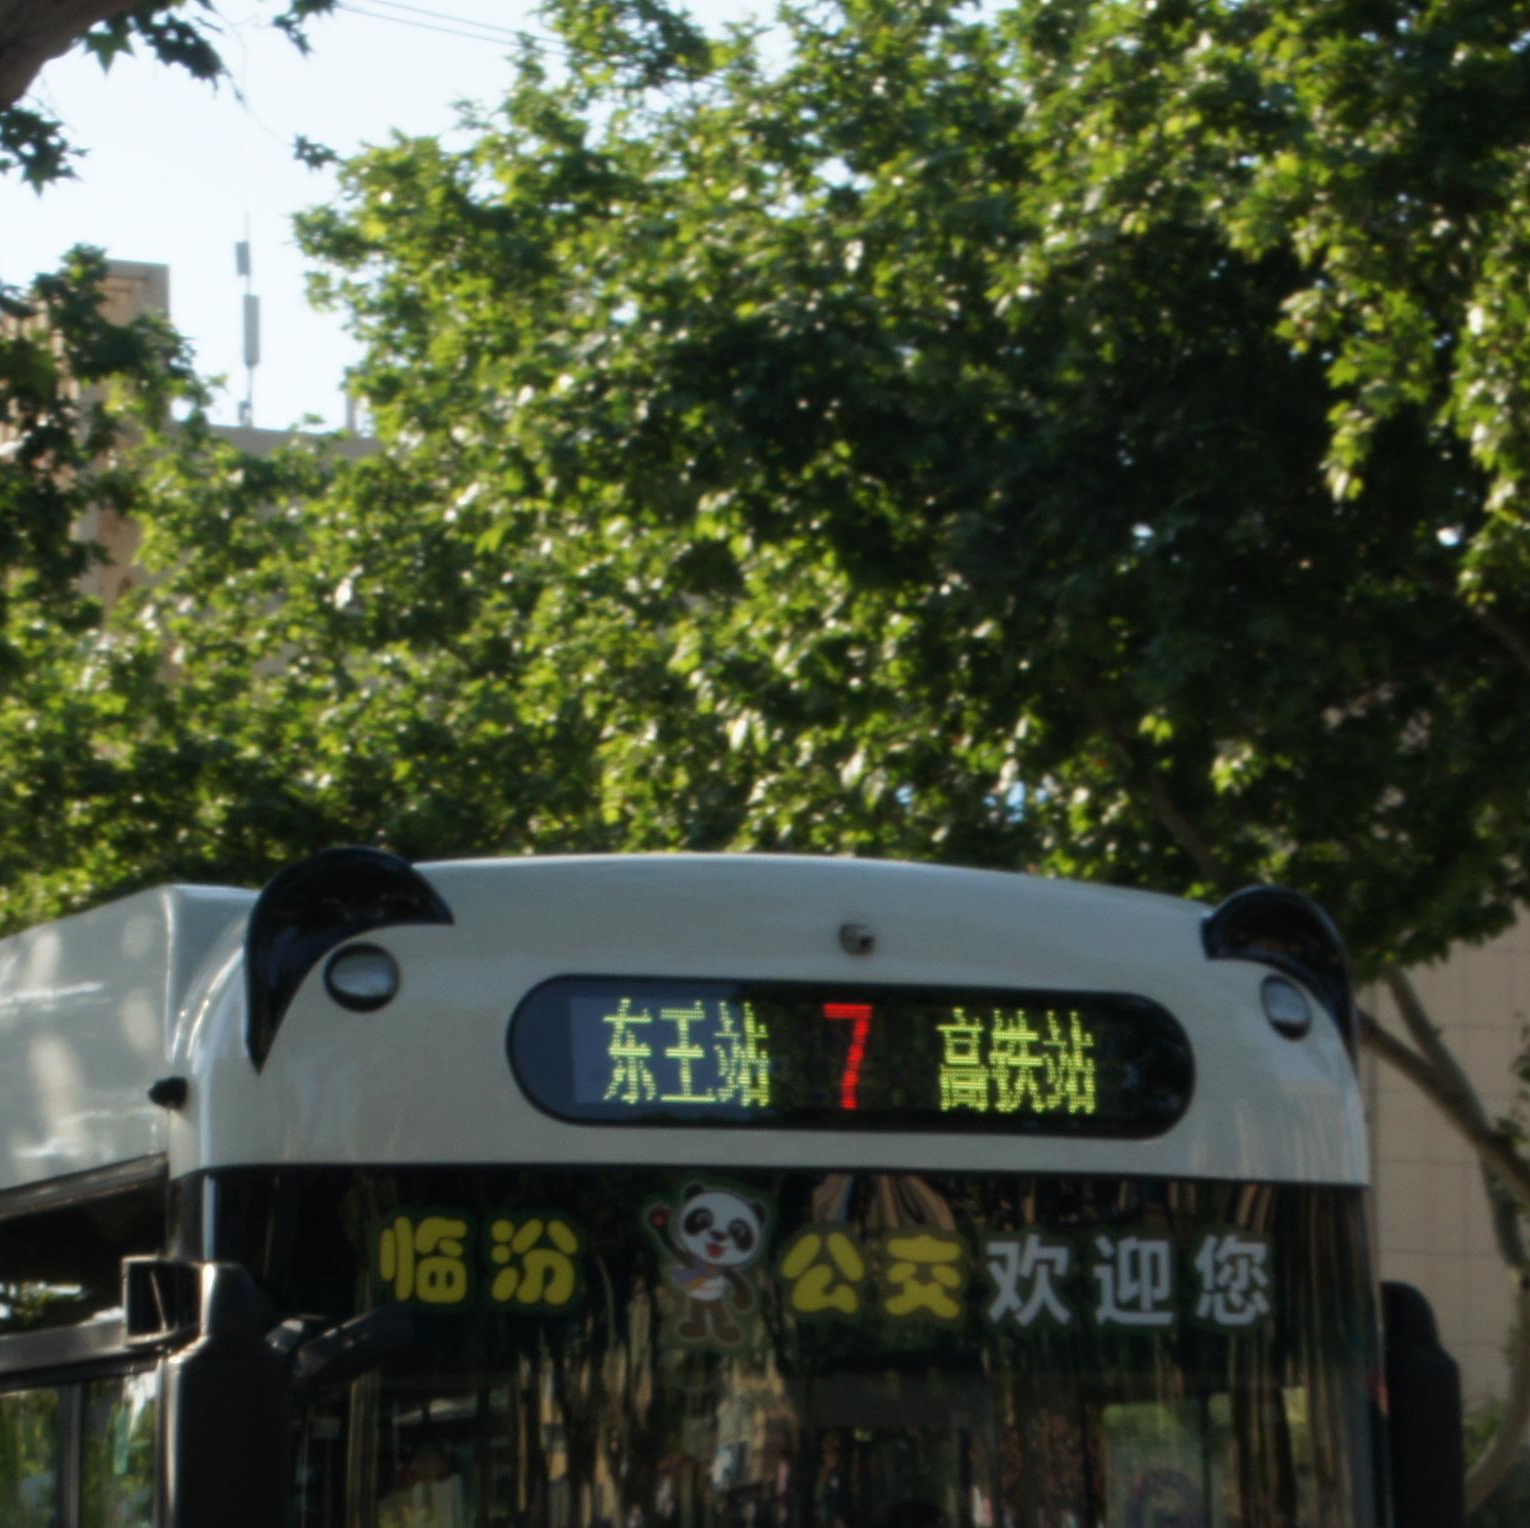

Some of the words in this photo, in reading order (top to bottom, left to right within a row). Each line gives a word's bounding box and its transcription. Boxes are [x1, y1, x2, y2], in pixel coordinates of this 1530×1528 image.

[603, 997, 772, 1109] 东王站
[823, 1002, 871, 1110] 7
[936, 1007, 1097, 1115] 高铁站
[378, 1215, 581, 1306] 临汾
